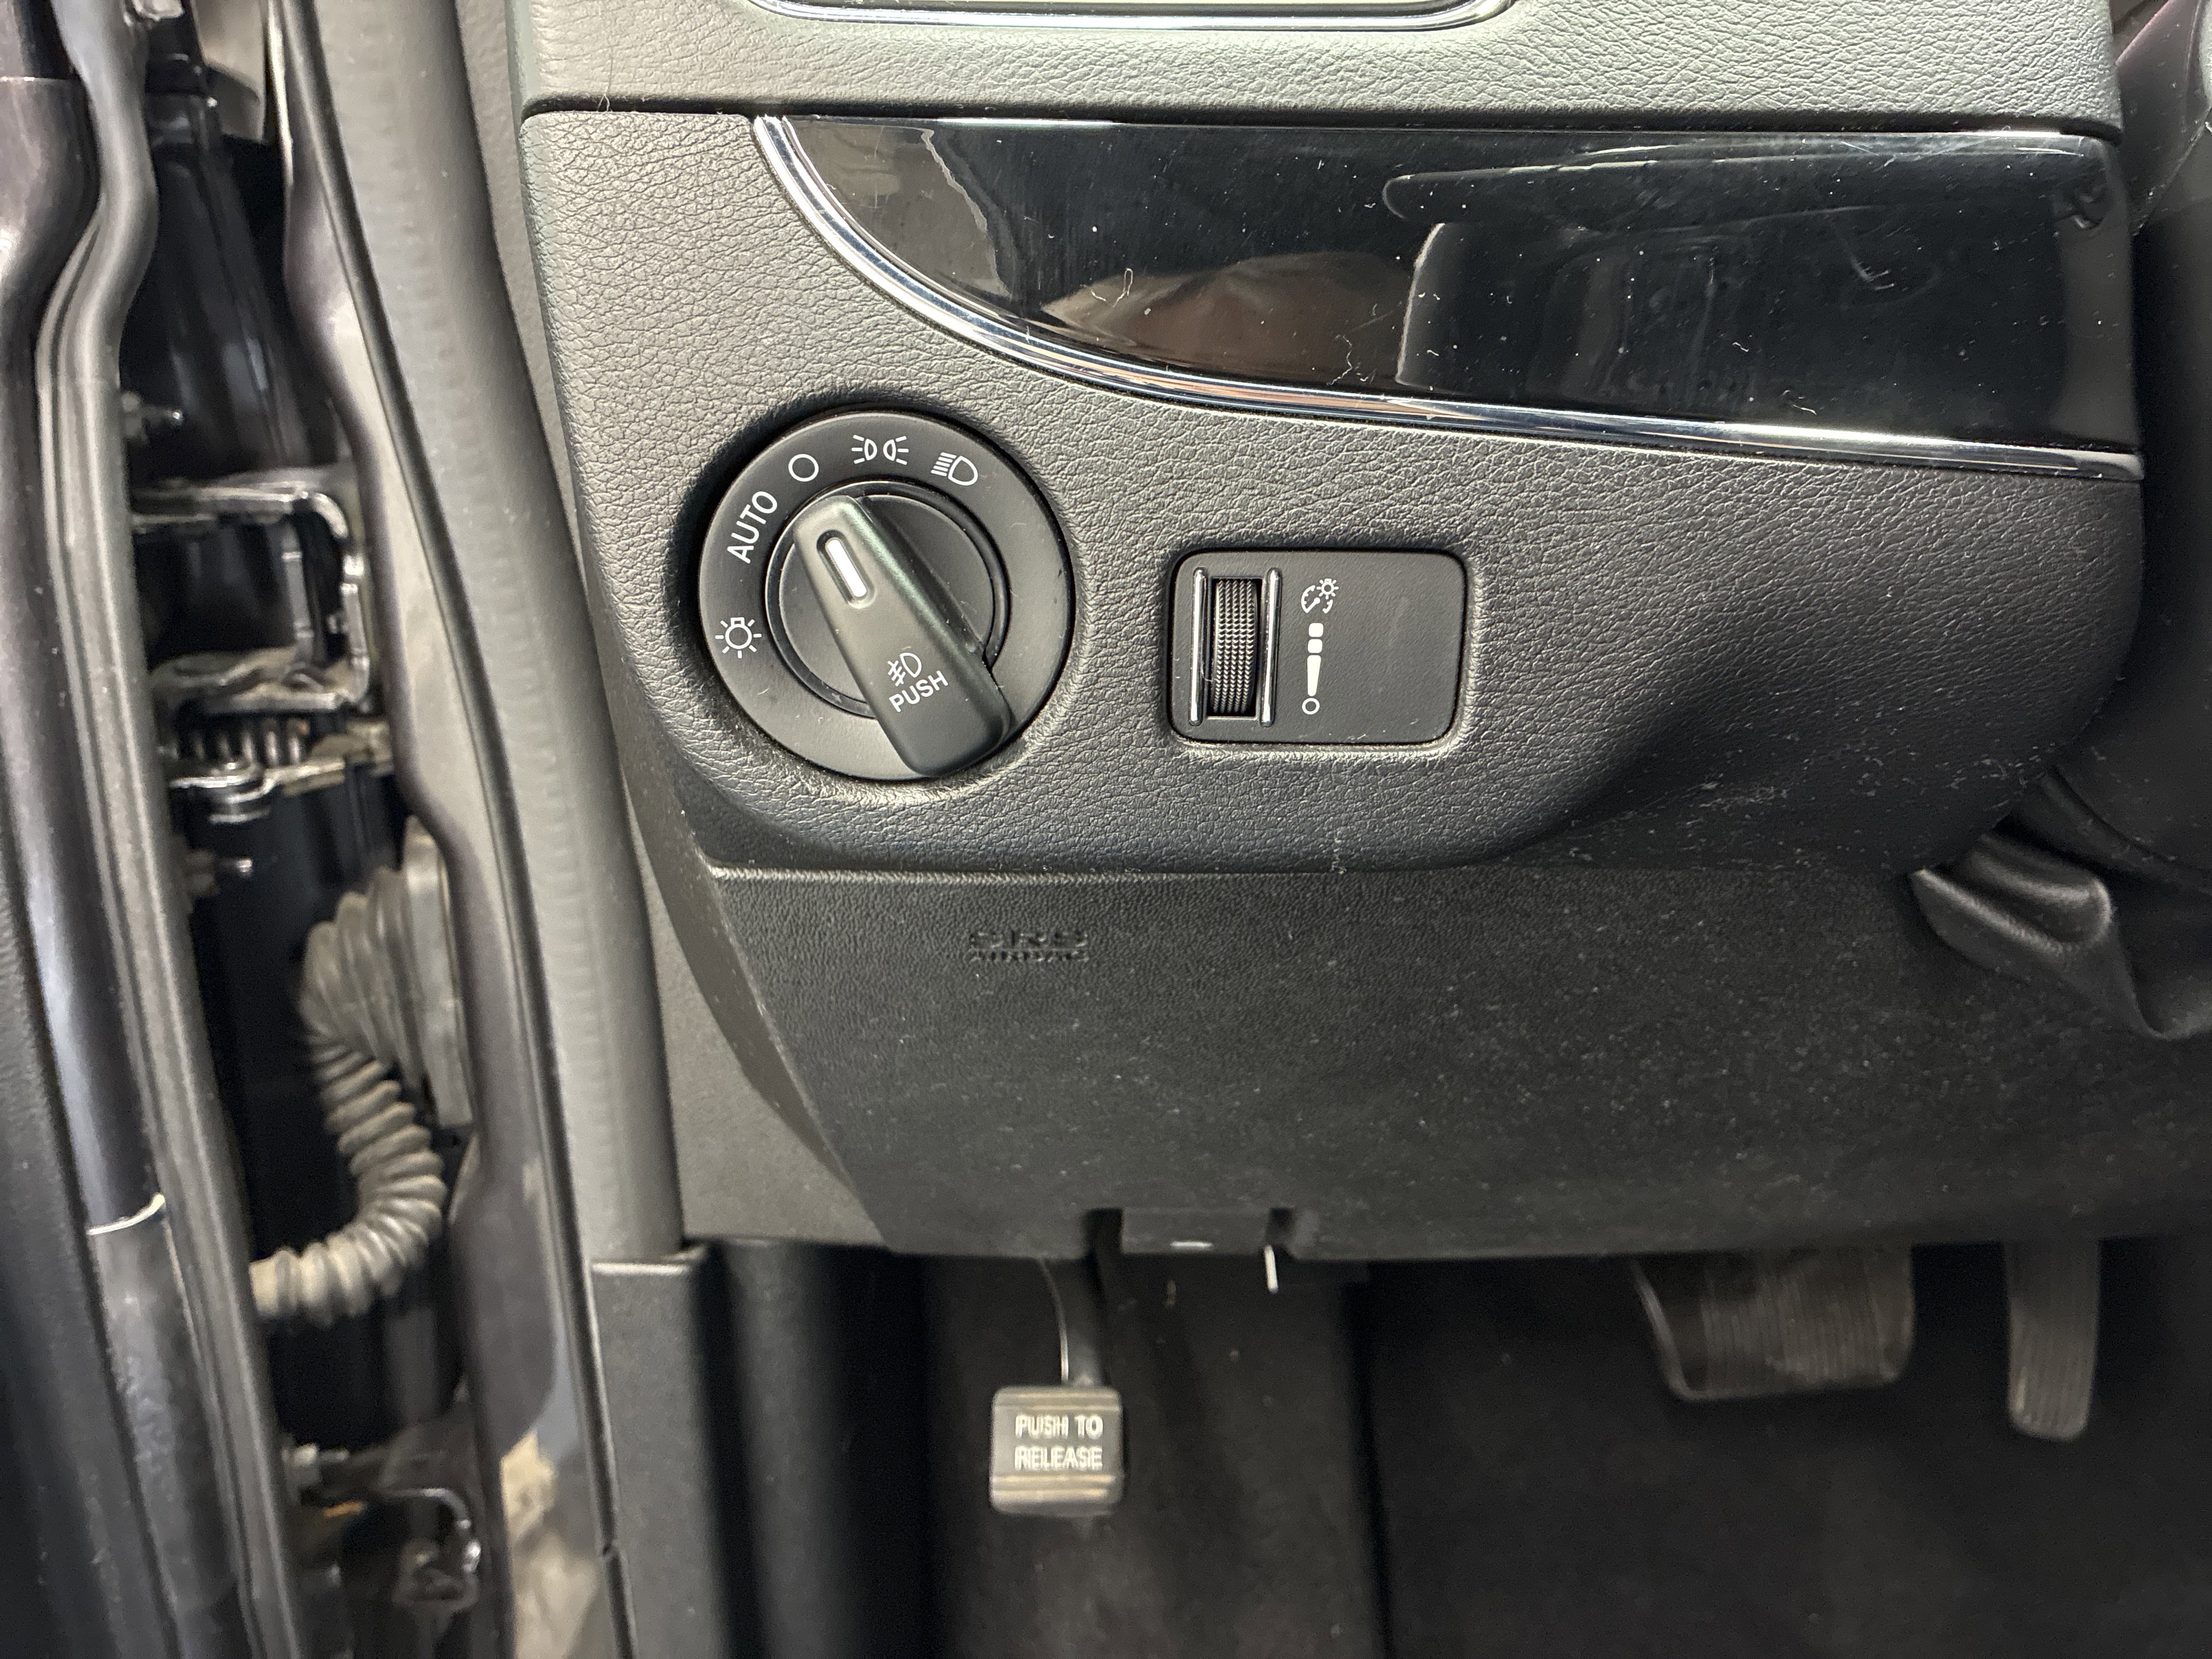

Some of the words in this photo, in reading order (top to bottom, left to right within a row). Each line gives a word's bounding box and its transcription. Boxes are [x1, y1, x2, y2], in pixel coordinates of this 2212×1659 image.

[727, 490, 778, 563] AUTO
[889, 670, 949, 713] PUSH
[1015, 1413, 1069, 1438] PUSH
[1074, 1413, 1103, 1438] TO
[1014, 1445, 1103, 1471] RELEASE
